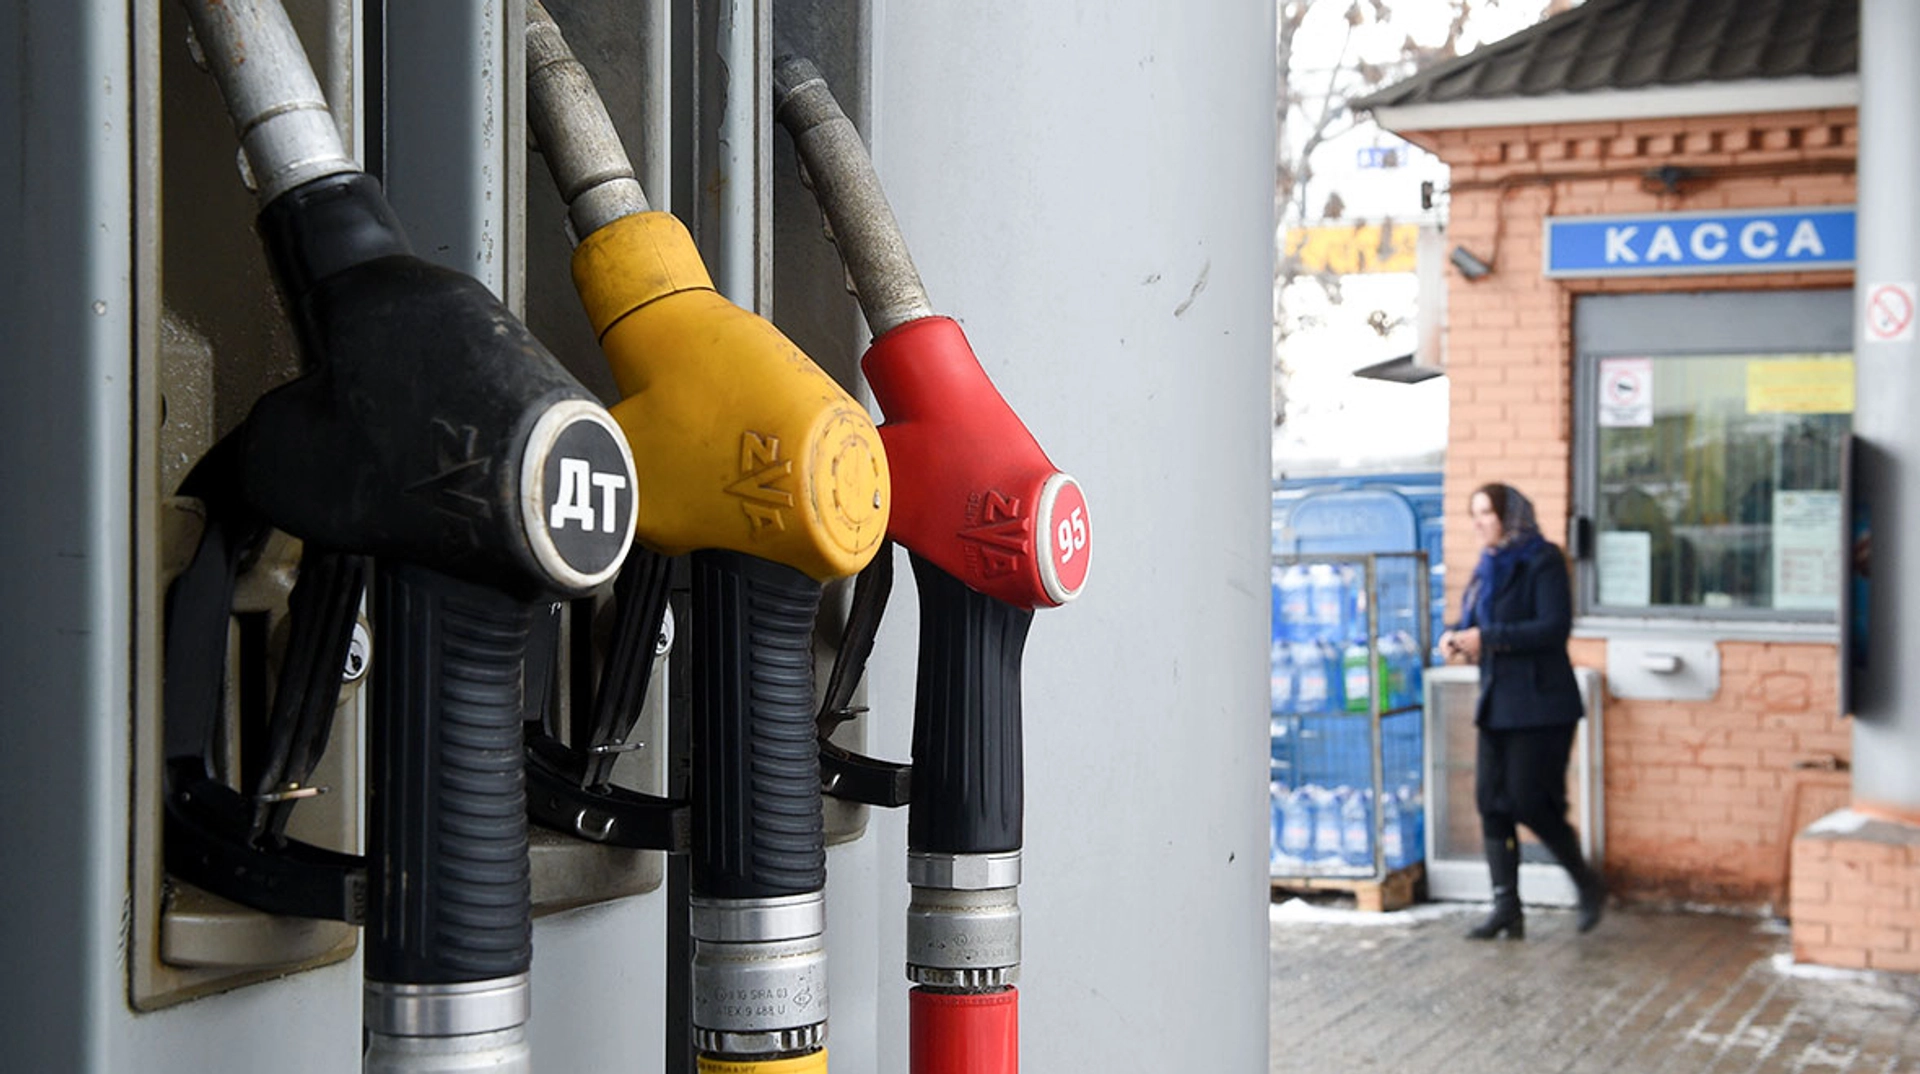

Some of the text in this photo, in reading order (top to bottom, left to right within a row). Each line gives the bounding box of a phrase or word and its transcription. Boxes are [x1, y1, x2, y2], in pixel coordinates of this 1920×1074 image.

[1605, 219, 1825, 263] КАССА
[550, 457, 626, 533] ДТ
[722, 429, 795, 541] ZVA
[956, 489, 1030, 579] ZVA
[1057, 506, 1086, 564] 95
